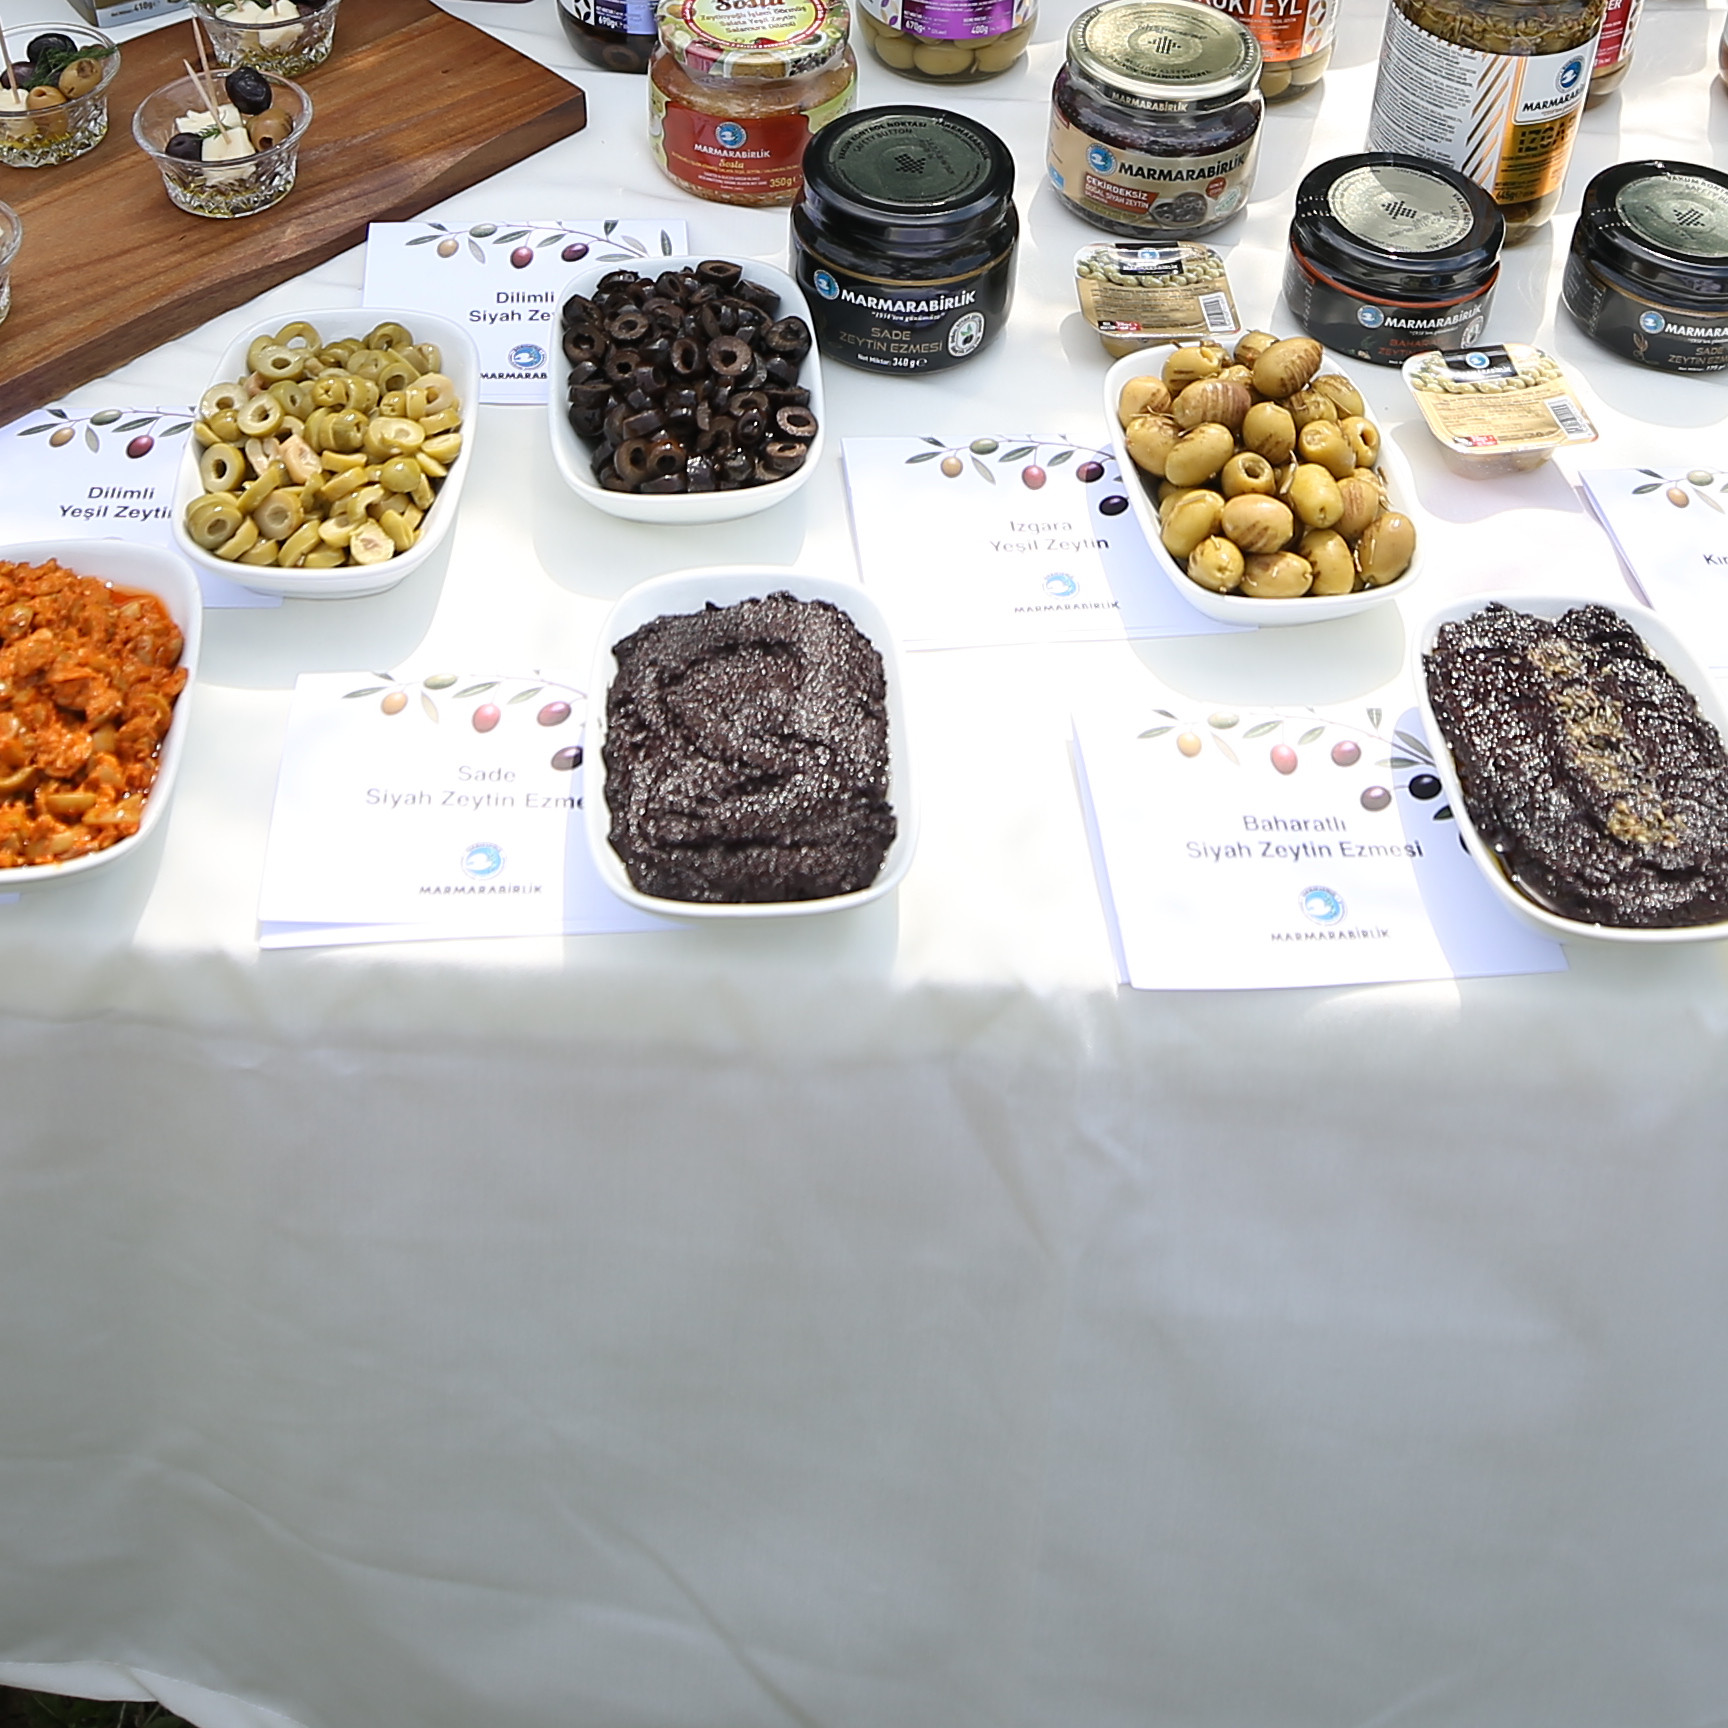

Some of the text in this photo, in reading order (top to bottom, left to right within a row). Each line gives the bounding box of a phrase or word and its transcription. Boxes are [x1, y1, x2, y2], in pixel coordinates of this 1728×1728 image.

[1111, 92, 1189, 112] MARMARABİRLİK
[877, 129, 912, 138] BUTTON
[694, 144, 770, 158] MARMARABİRLİK
[719, 158, 744, 168] Soslu
[1118, 154, 1244, 182] MARMARABİRLİK
[770, 178, 792, 188] 350g
[1086, 175, 1148, 201] ÇEKİRDEKSİZ
[496, 291, 555, 304] Dilimli
[841, 289, 977, 313] MARMARABİRLİK
[469, 310, 522, 325] Siyah
[1384, 303, 1483, 329] MARMARABİRLİK
[871, 327, 911, 340] SADE
[839, 331, 943, 353] ZEYTİN EZMESİ
[1695, 347, 1724, 356] SADE
[858, 354, 868, 362] Net
[892, 357, 908, 367] 340
[480, 372, 548, 380] MARMARAB
[88, 486, 155, 500] Dilimli
[59, 505, 108, 521] Yeşil
[1010, 521, 1072, 535] Izgara
[990, 538, 1110, 554] Yeşil Zeytin
[1015, 601, 1120, 614] MARMARABİRLİK
[458, 765, 516, 783] Sade
[366, 788, 585, 811] Siyah Zeytin Ezme
[1242, 814, 1347, 832] Baharatlı
[1186, 839, 1424, 862] Siyah Zeytin Ezmesi
[419, 883, 543, 895] MARMARABİRLİK
[1271, 925, 1391, 942] MARMARABİRLİK
